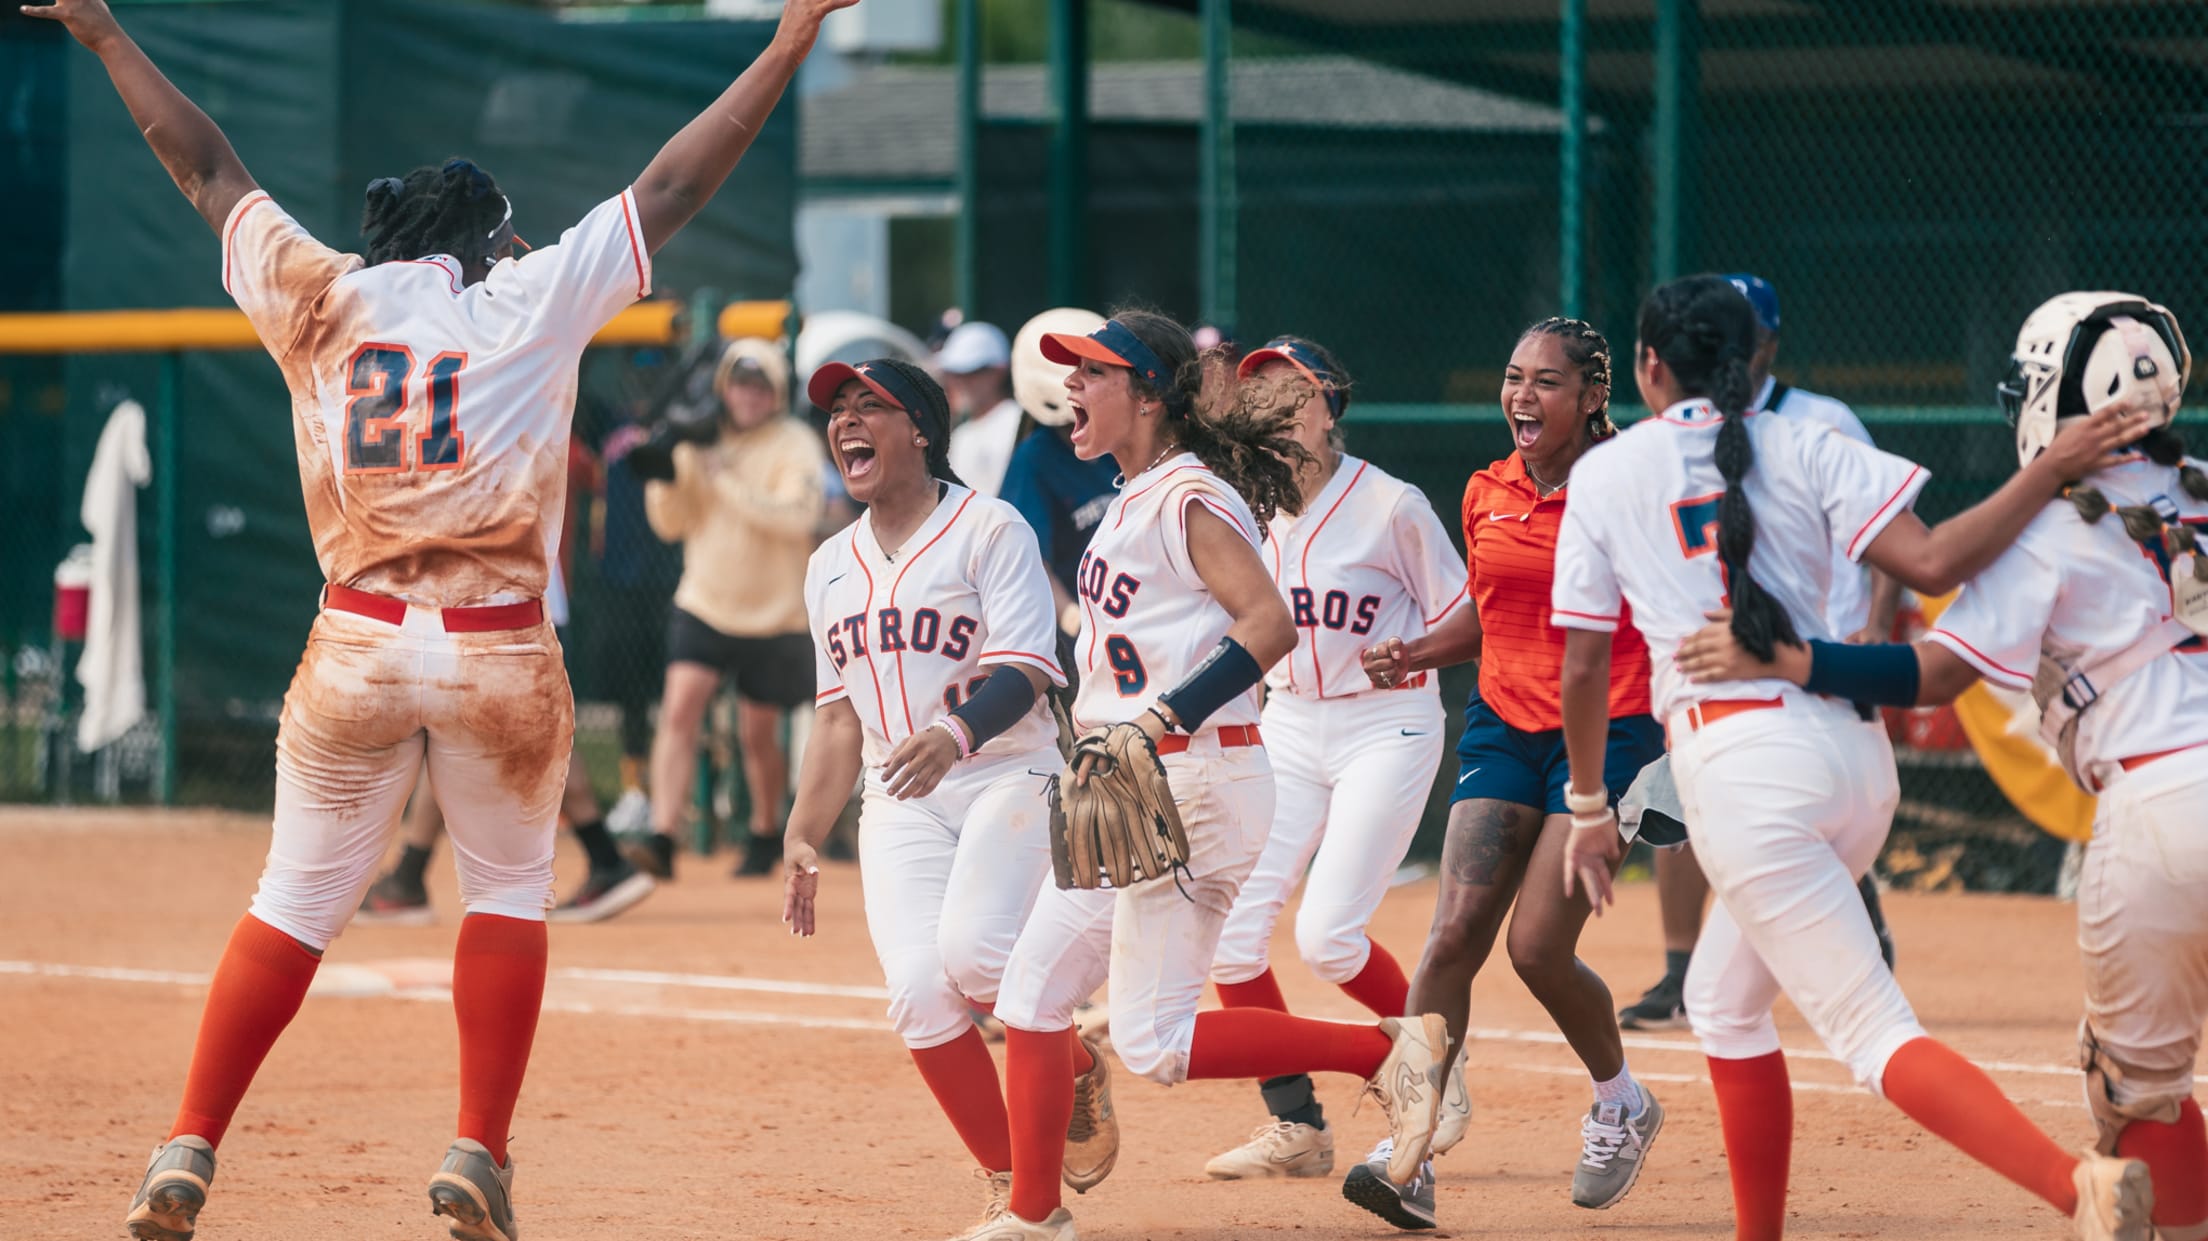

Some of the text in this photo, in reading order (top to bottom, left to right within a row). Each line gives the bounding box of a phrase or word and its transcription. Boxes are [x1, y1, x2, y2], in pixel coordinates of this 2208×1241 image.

[342, 341, 468, 475] 21
[827, 606, 978, 670] STROS
[1290, 587, 1381, 636] ROS
[1104, 634, 1148, 698] 9
